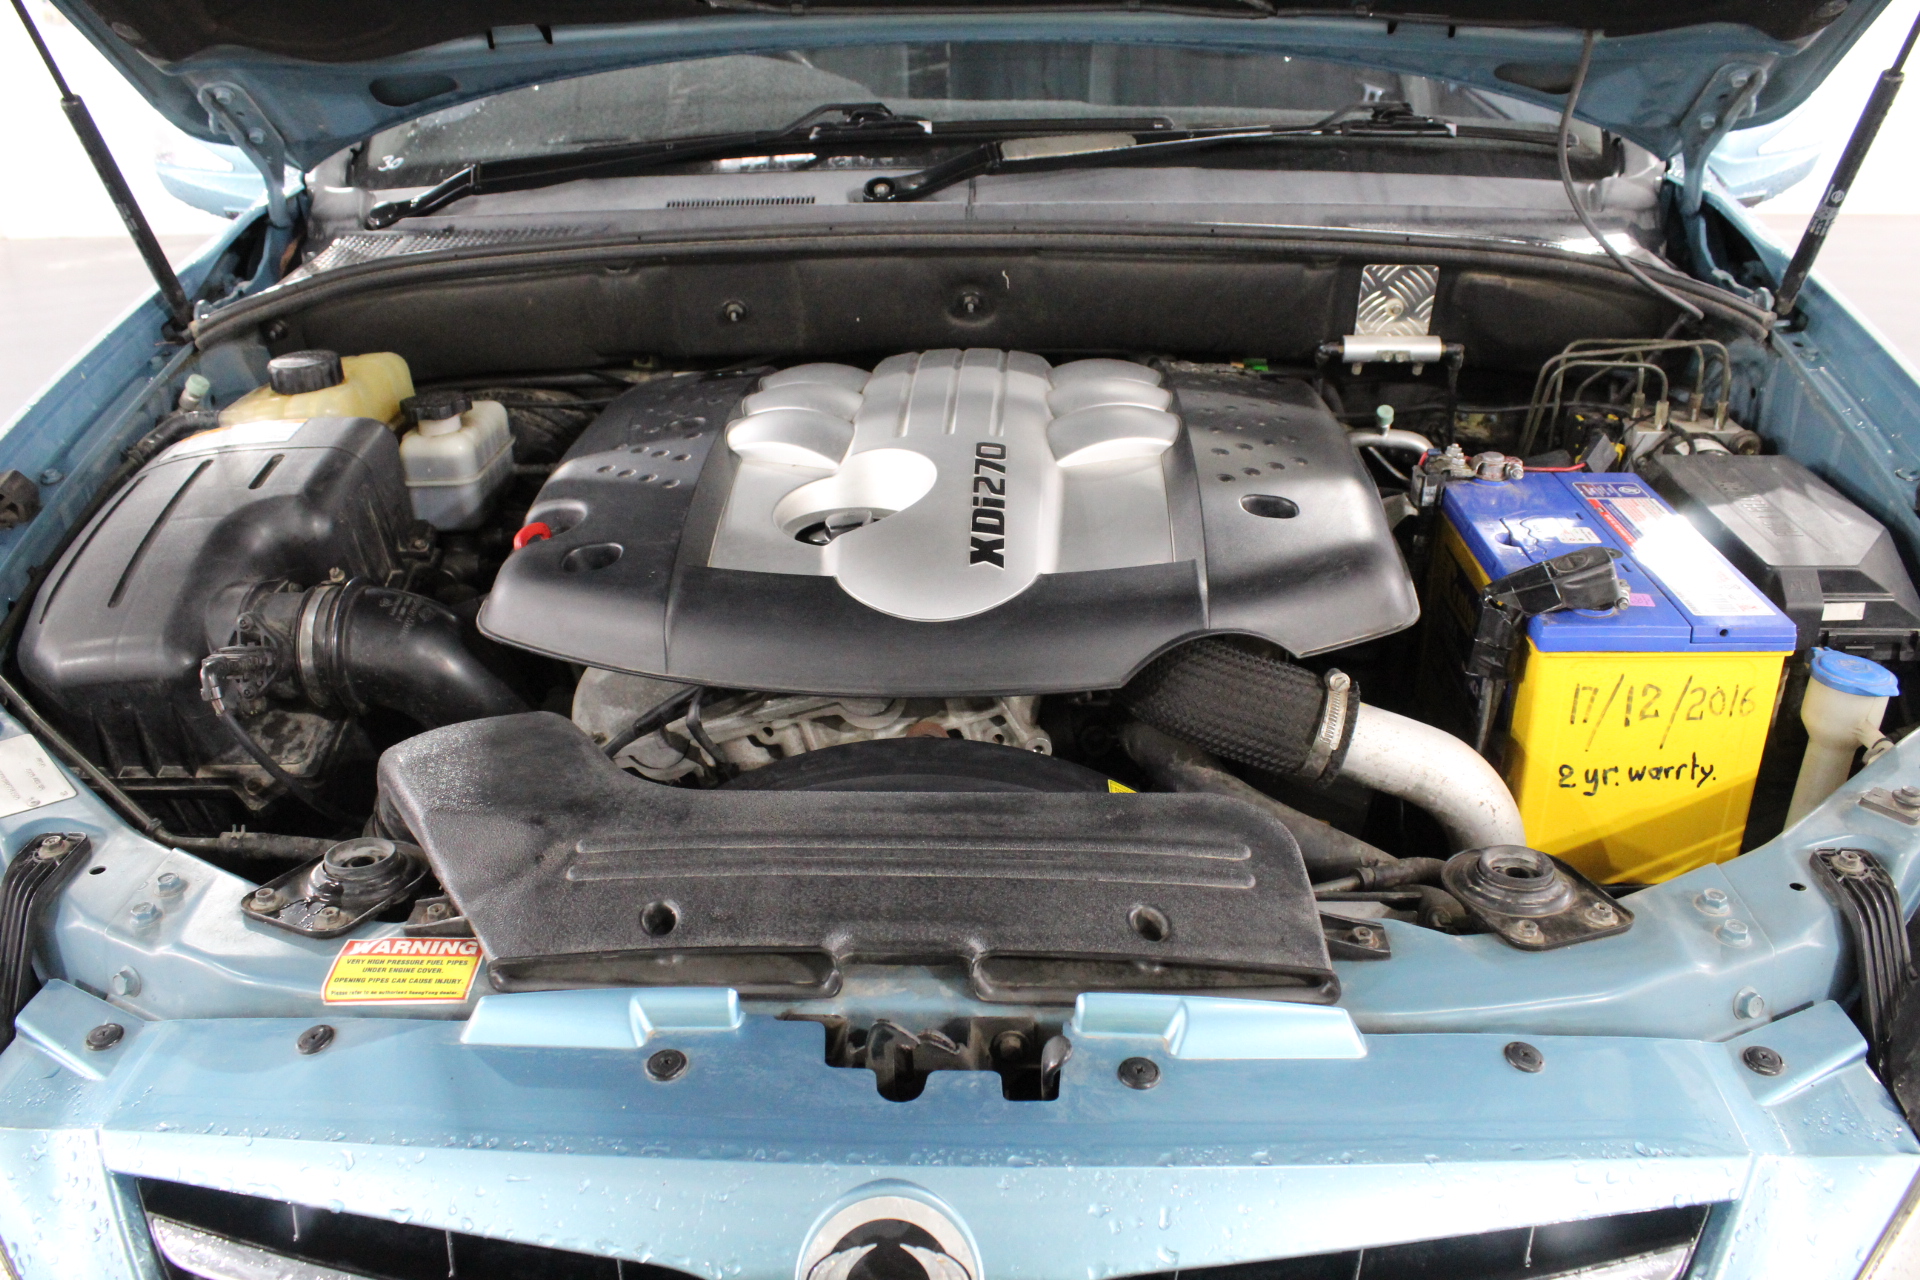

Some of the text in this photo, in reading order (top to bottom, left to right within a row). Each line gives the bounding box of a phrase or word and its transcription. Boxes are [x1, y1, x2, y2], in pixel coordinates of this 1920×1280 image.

[970, 441, 1006, 570] XDi270
[1570, 673, 1757, 752] 17/12/2016
[1558, 763, 1577, 788] 2
[1583, 766, 1620, 796] yr.
[349, 940, 479, 955] WARNING
